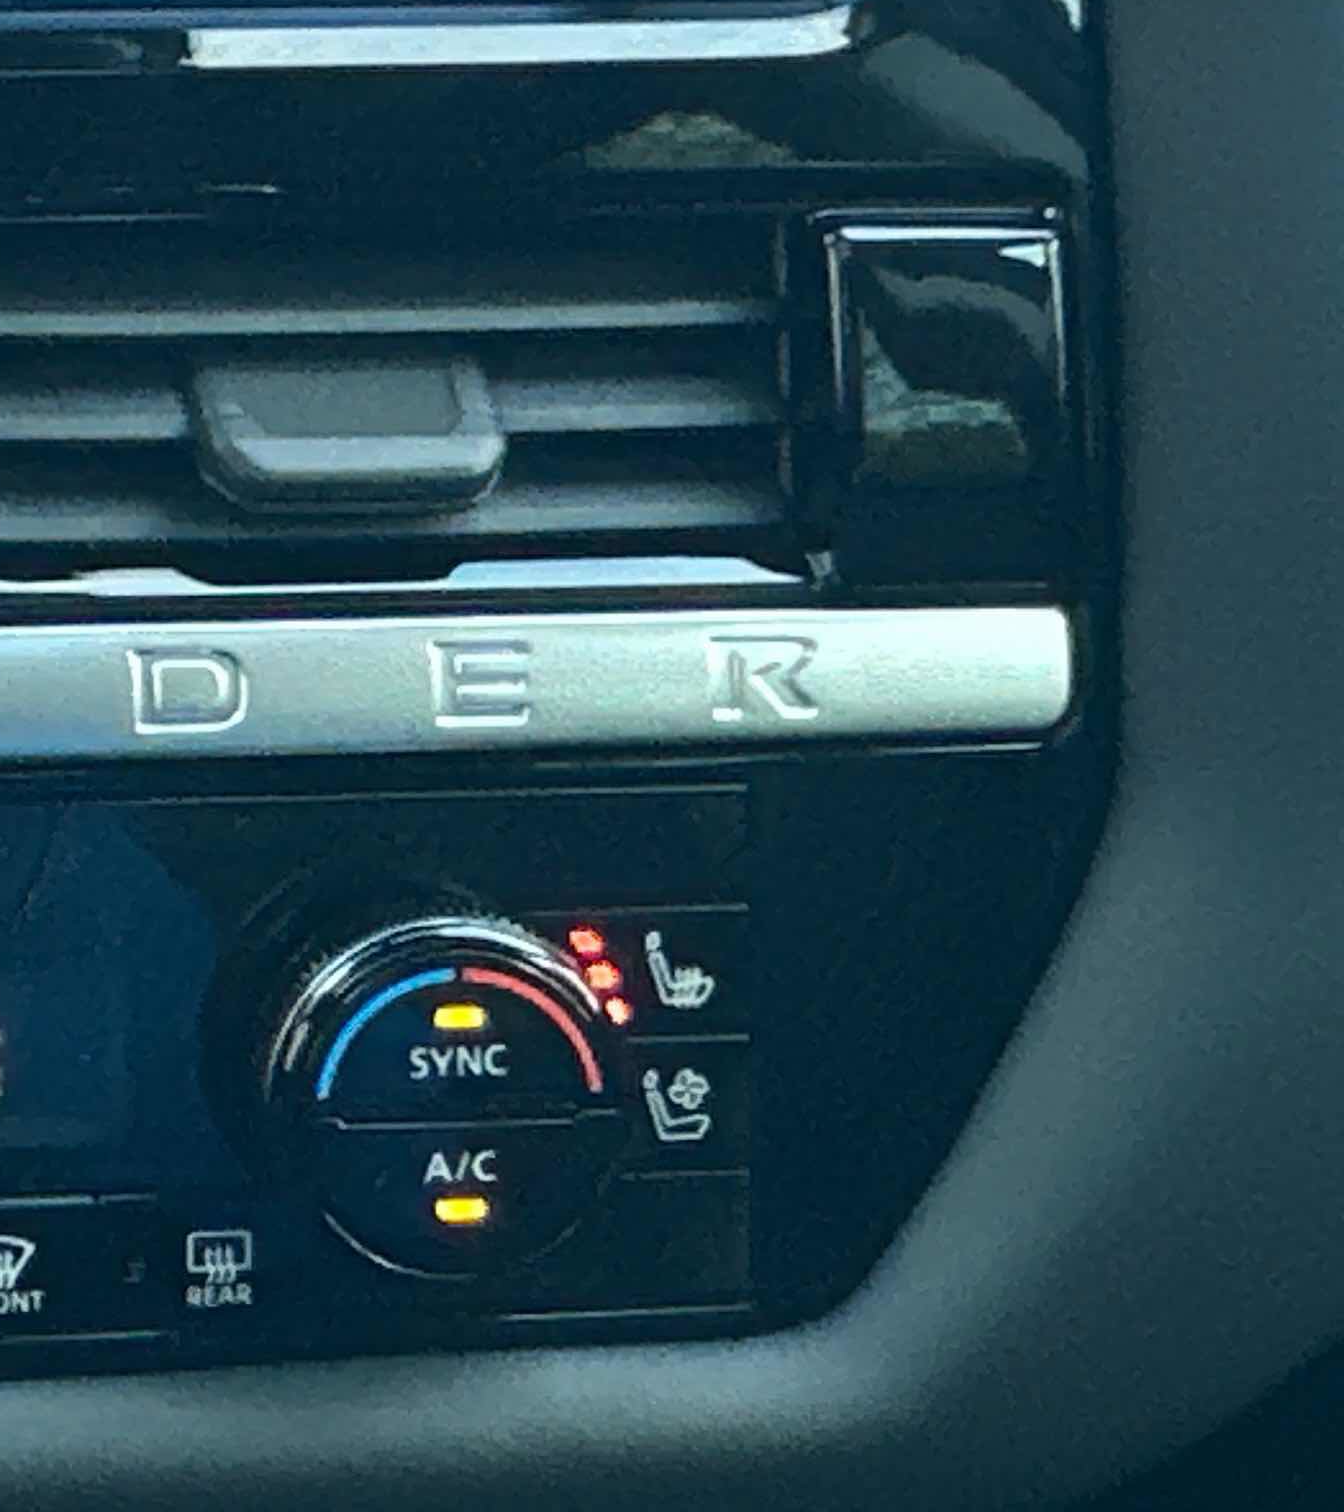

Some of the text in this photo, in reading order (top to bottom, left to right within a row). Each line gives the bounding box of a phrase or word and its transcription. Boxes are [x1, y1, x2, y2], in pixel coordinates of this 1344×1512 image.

[410, 1045, 510, 1078] SYNC
[423, 1150, 497, 1183] A/C
[186, 1283, 252, 1307] REAR
